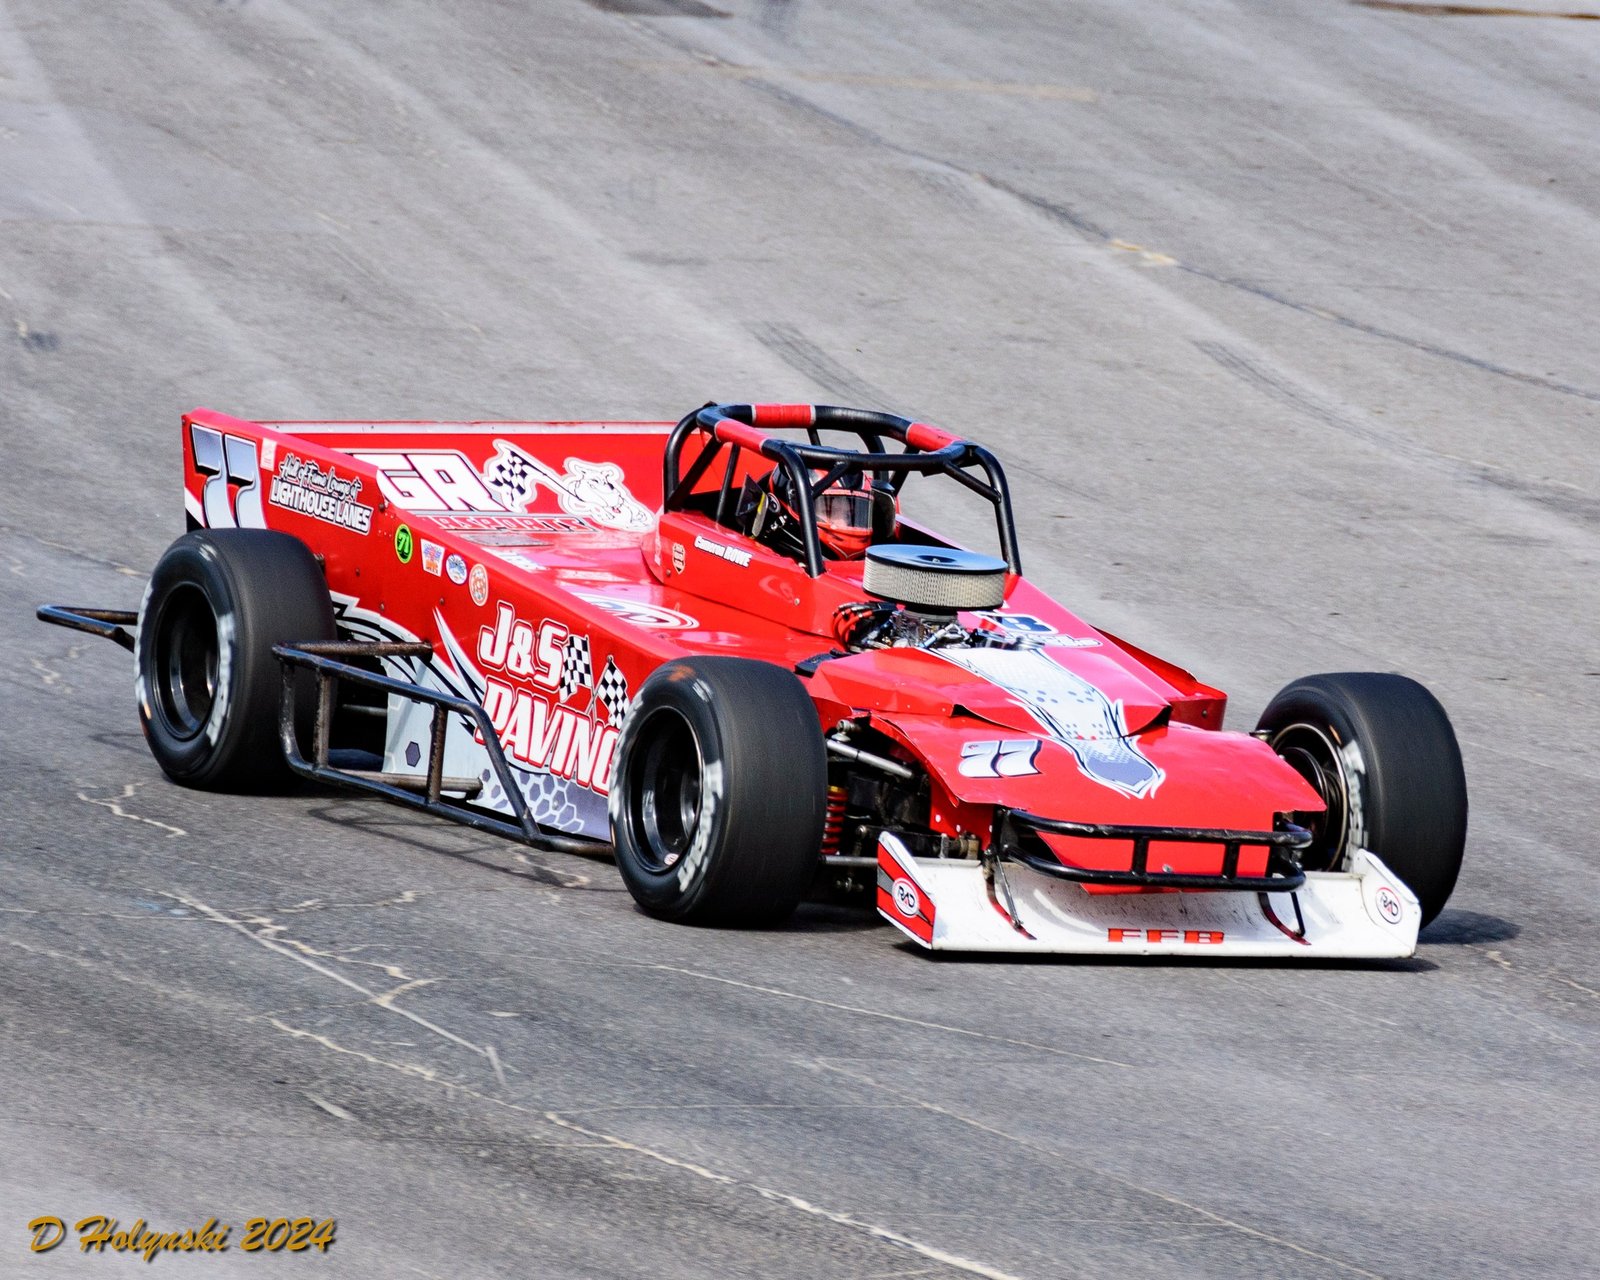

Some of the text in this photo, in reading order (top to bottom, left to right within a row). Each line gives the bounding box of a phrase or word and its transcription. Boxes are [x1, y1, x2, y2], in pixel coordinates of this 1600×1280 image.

[191, 424, 266, 529] 77
[269, 477, 371, 533] LIGHTHOUSE LANES
[480, 602, 569, 690] J&S
[958, 739, 1042, 778] 77
